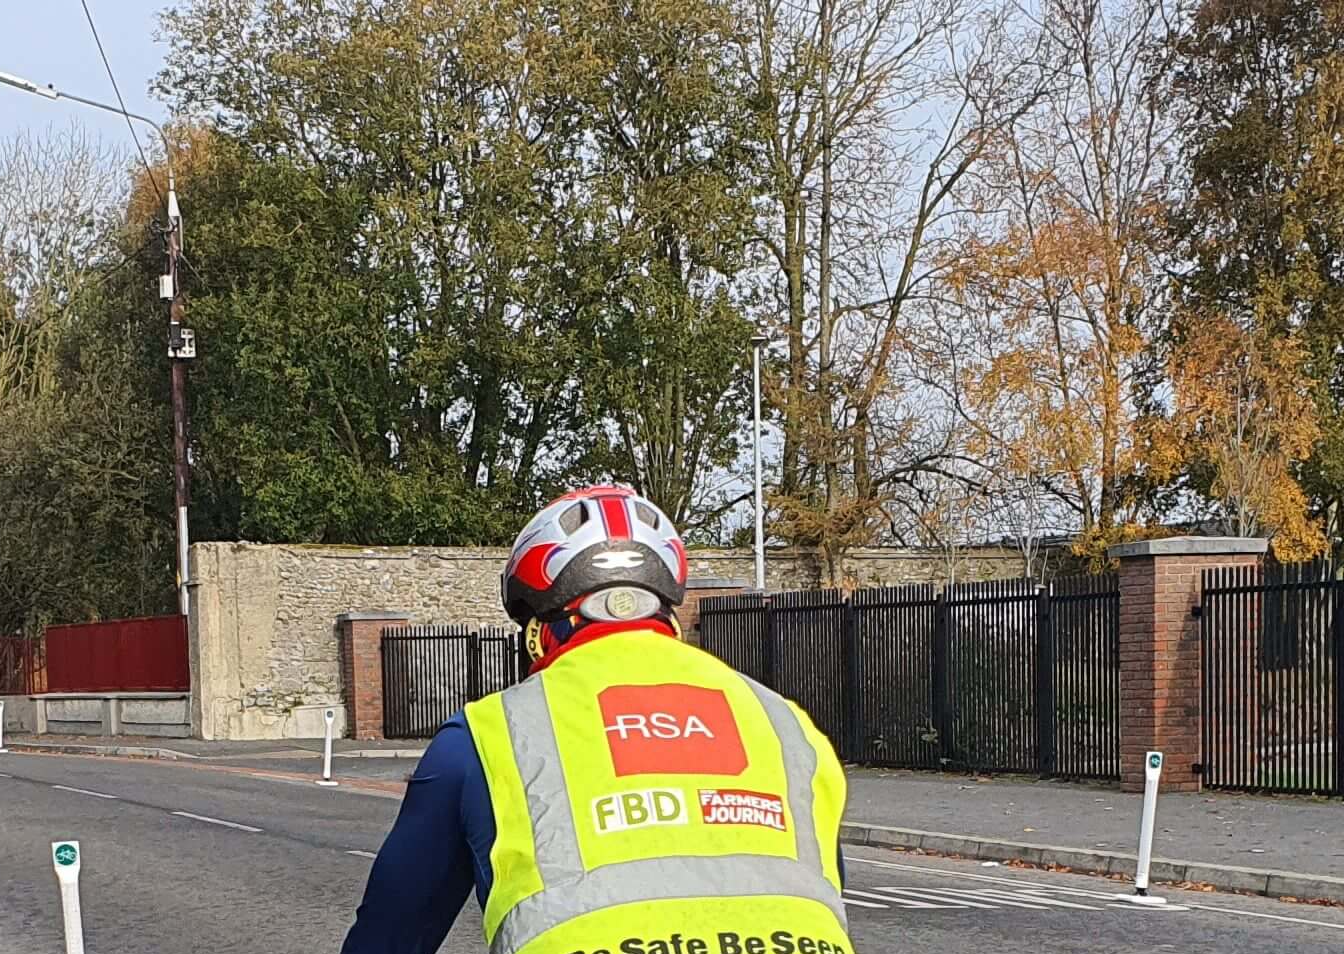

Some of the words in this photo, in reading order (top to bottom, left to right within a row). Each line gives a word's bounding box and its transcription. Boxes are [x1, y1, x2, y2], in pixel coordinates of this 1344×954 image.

[606, 712, 715, 739] RSA
[596, 791, 681, 830] FBD
[700, 793, 783, 813] FARMERS
[704, 805, 785, 830] JOURNAL
